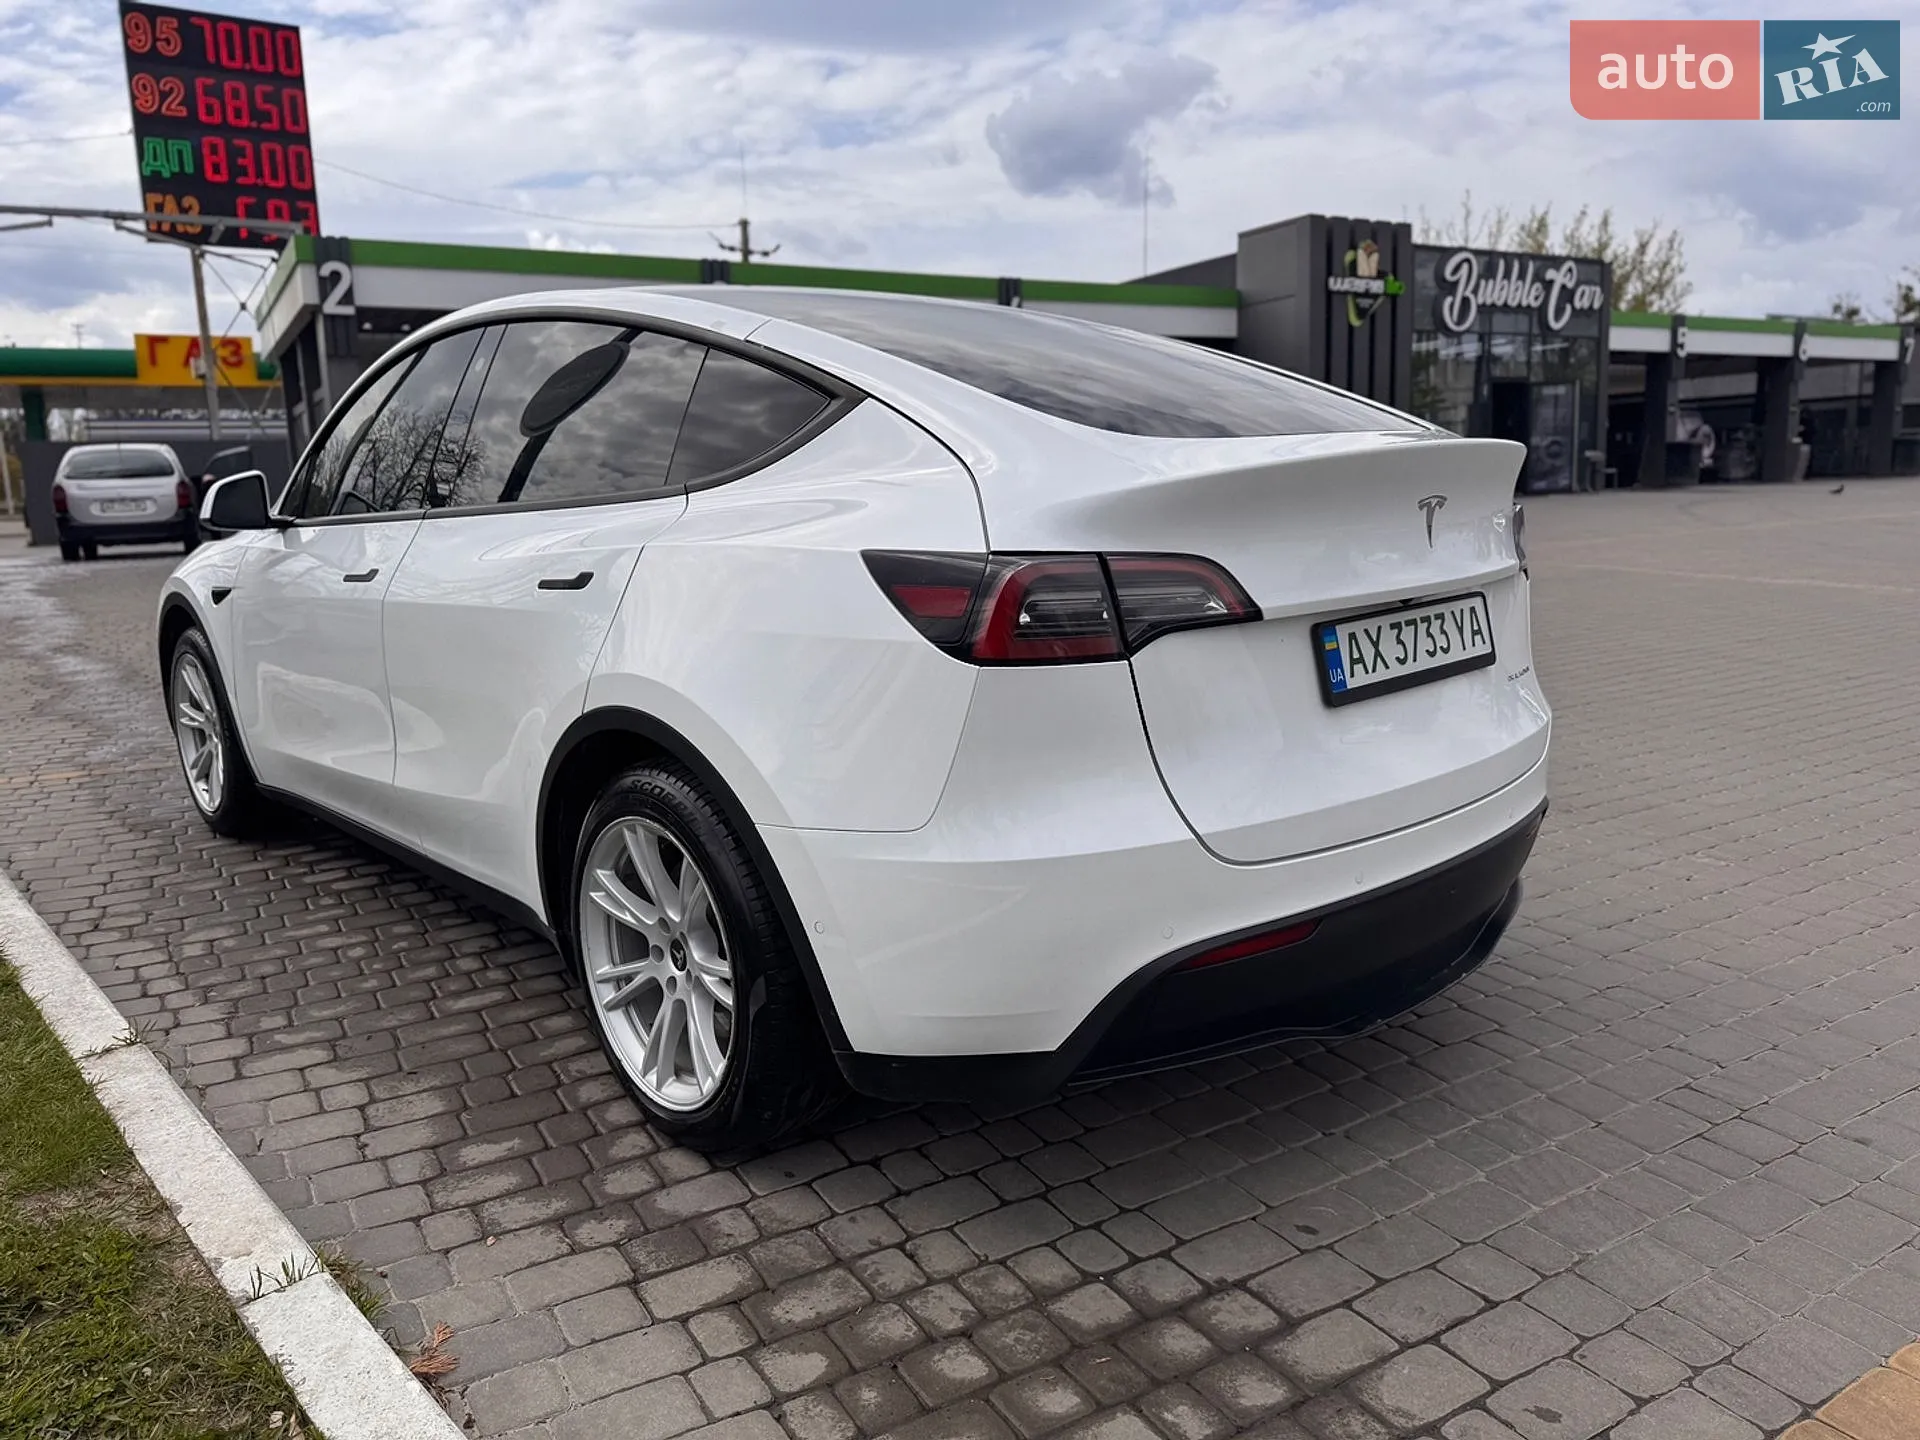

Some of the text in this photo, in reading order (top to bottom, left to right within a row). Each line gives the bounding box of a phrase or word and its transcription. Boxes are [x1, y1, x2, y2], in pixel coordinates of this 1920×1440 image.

[124, 12, 300, 77] 95 70.00
[131, 73, 307, 134] 92 68.50
[141, 137, 313, 189] ДП 83.00
[145, 192, 202, 234] ГАЗ
[319, 260, 355, 315] 2
[1442, 251, 1604, 332] Bubble Car
[1676, 325, 1689, 358] 5
[1904, 337, 1916, 364] 7
[1347, 605, 1486, 679] AX 3733 YA
[1330, 668, 1345, 684] UA
